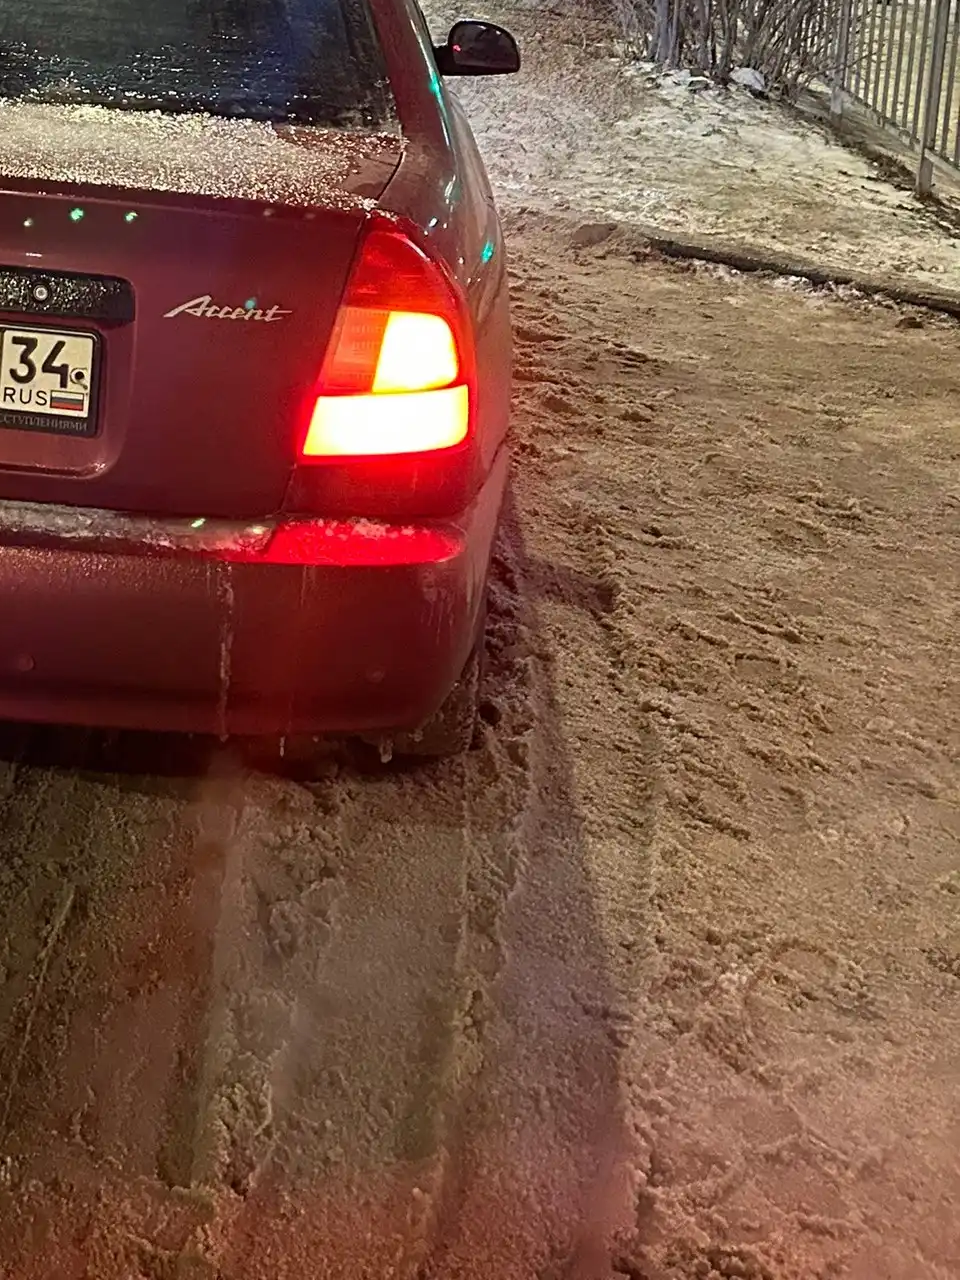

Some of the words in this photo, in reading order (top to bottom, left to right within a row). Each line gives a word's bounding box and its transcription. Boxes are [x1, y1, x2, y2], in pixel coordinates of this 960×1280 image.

[163, 295, 293, 322] Accent
[9, 336, 69, 389] 34
[3, 387, 48, 407] RUS
